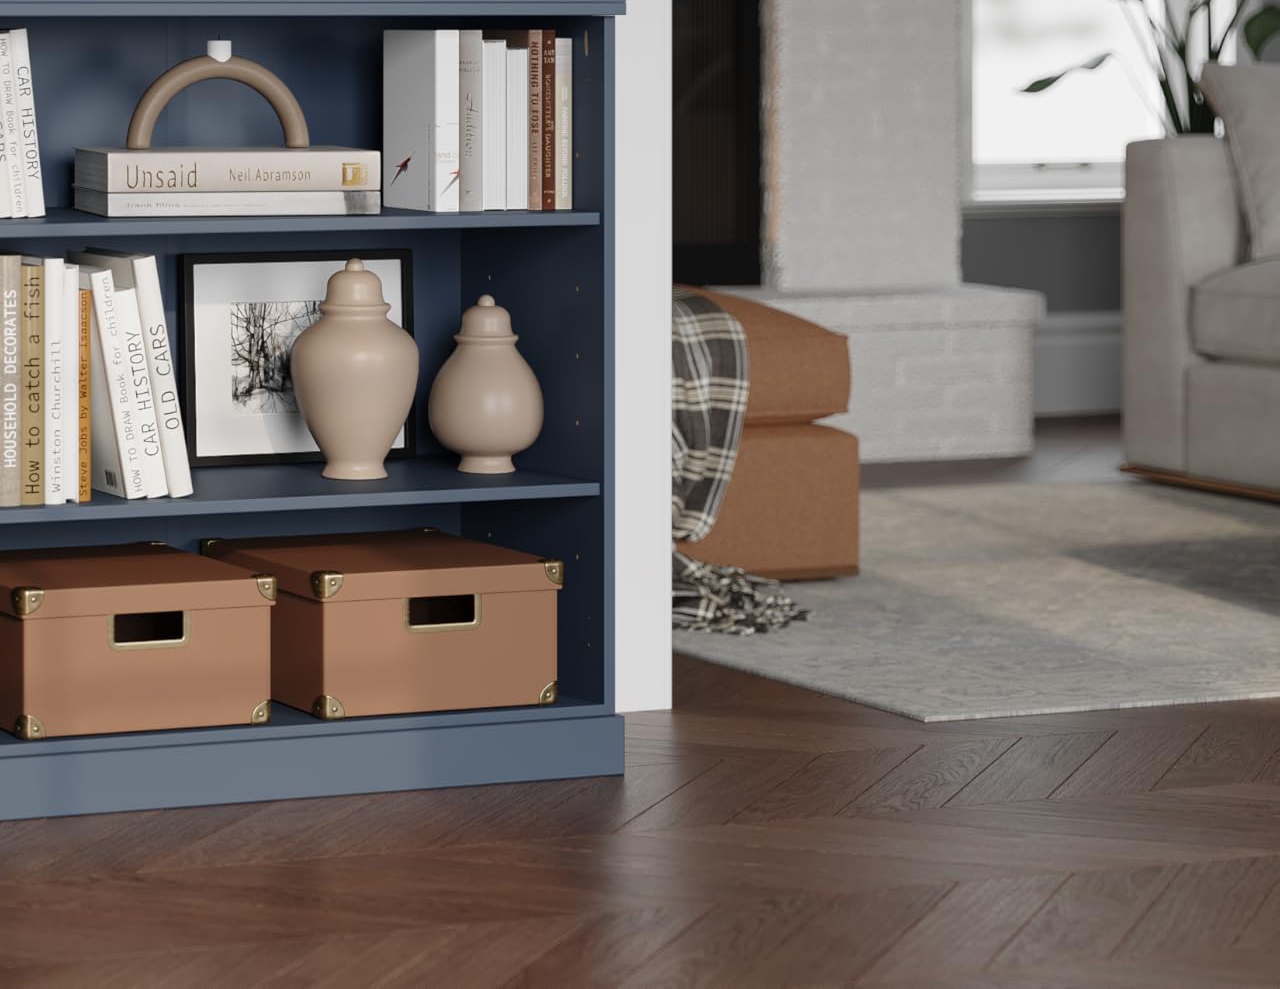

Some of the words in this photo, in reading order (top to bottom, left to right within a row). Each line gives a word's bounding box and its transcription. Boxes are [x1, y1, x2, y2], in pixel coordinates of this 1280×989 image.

[0, 38, 8, 57] HOW
[1, 64, 10, 75] TO
[531, 41, 539, 88] NOTHING
[3, 80, 13, 105] DRAW
[16, 66, 32, 97] CAR
[531, 92, 539, 106] TO
[6, 110, 16, 134] Book
[531, 109, 539, 134] LOSE
[9, 141, 18, 157] for
[21, 107, 40, 181] HISTORY
[11, 164, 24, 214] children
[125, 162, 198, 189] Unsaid
[228, 167, 251, 182] Neil
[255, 167, 312, 182] Abramson
[23, 276, 40, 321] fish
[102, 276, 120, 337] children
[3, 289, 17, 374] DECORATES
[78, 292, 88, 348] Isaacson
[28, 333, 40, 344] a
[112, 344, 123, 366] for
[149, 323, 172, 377] CARS
[23, 357, 40, 414] catch
[50, 339, 62, 420] Churchill
[78, 356, 88, 399] Walter
[124, 330, 153, 412] HISTORY
[115, 373, 129, 404] Book
[3, 382, 17, 468] HOUSEHOLD
[78, 405, 90, 419] by
[122, 410, 135, 441] DRAW
[160, 390, 180, 431] OLD
[24, 426, 40, 447] to
[78, 426, 88, 453] Jobs
[141, 420, 159, 457] CAR
[50, 429, 62, 493] Winston
[129, 447, 138, 461] TO
[24, 460, 40, 495] How
[78, 461, 88, 496] Steve
[132, 468, 144, 493] HOW
